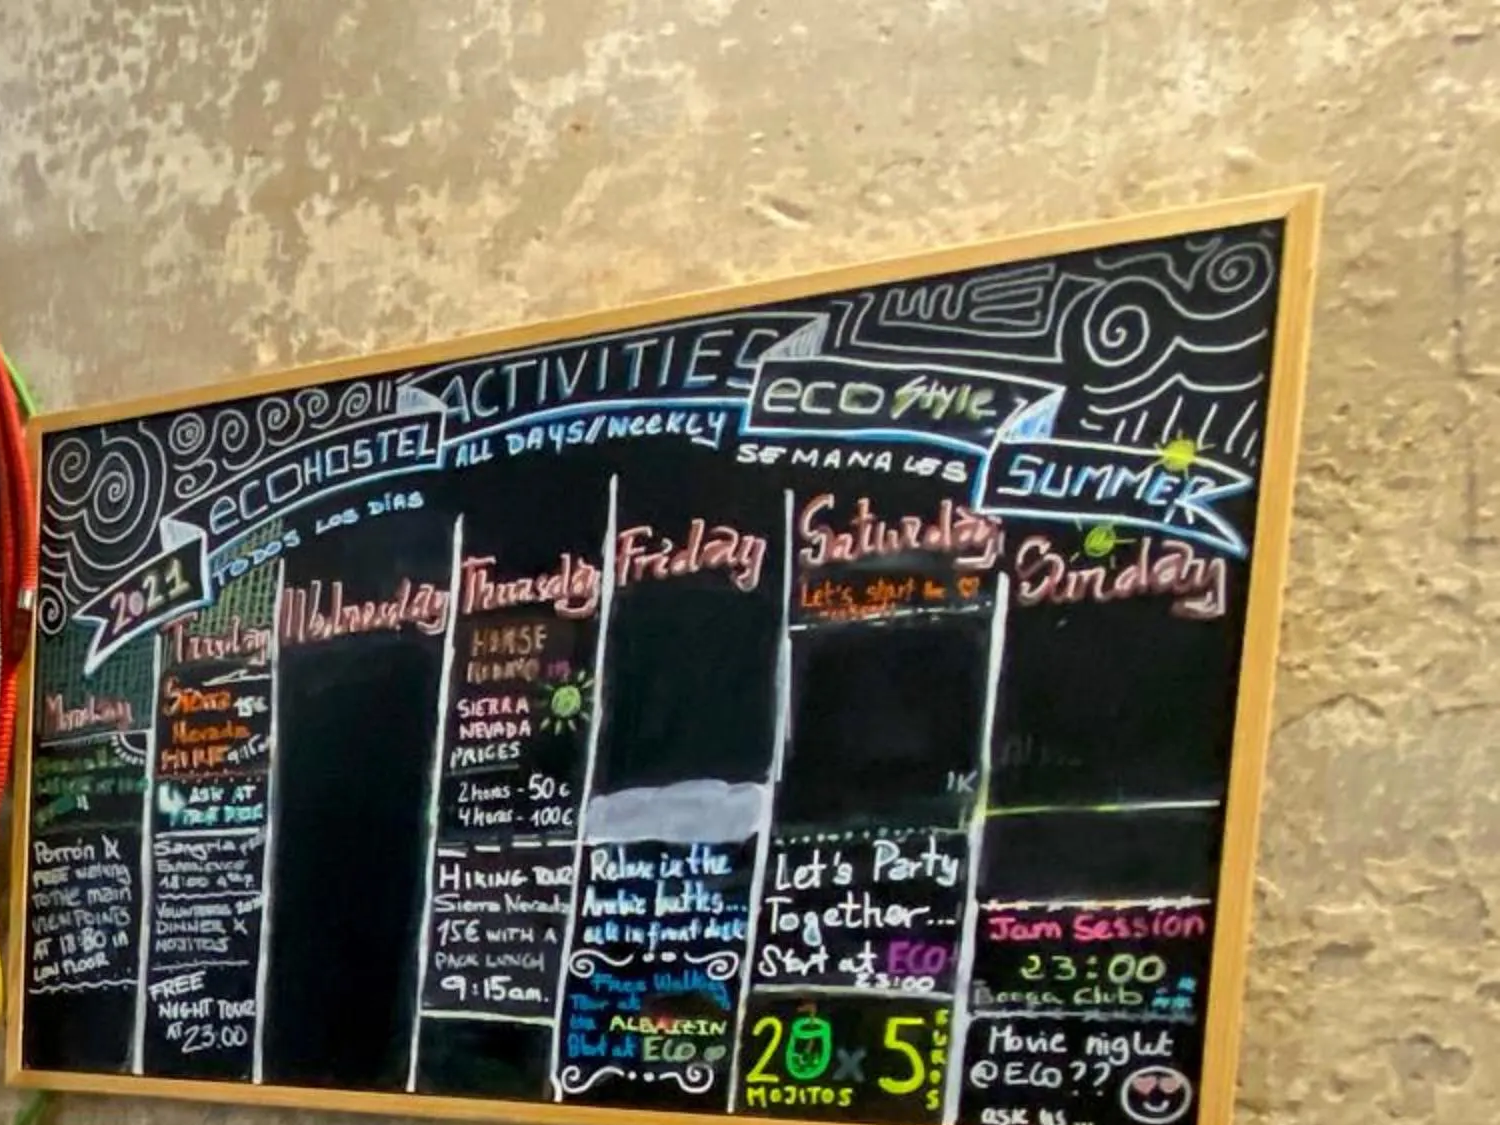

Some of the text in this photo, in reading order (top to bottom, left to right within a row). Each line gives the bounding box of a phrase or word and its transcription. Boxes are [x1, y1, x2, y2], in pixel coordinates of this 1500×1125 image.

[439, 327, 780, 424] ACTIVITIES
[455, 440, 494, 469] ALL
[1007, 454, 1218, 525] SUMMER
[799, 493, 1004, 570] Saturday
[211, 527, 301, 587] TODOS
[315, 509, 360, 534] LOS
[615, 517, 768, 593] Friday
[462, 551, 604, 618] Thursday
[1015, 535, 1227, 619] Sunday
[110, 558, 192, 634] 2021
[455, 696, 531, 718] SIERRA
[458, 719, 532, 740] NEVADA
[449, 740, 522, 769] PRICES
[774, 834, 960, 892] Let's Party
[436, 917, 558, 948] 15€ WITH A
[987, 910, 1207, 942] Jam Session
[434, 950, 480, 972] PACK
[757, 939, 950, 977] Start at ECO
[1018, 953, 1168, 984] 23:00
[149, 970, 206, 1001] FREE
[1072, 985, 1145, 1007] Club
[158, 997, 258, 1019] NIGHT TOUR
[165, 1021, 184, 1042] AT
[987, 1024, 1176, 1067] Movie night
[745, 1015, 784, 1084] 2
[877, 1015, 927, 1096] 5
[745, 1085, 855, 1109] MOJITOS
